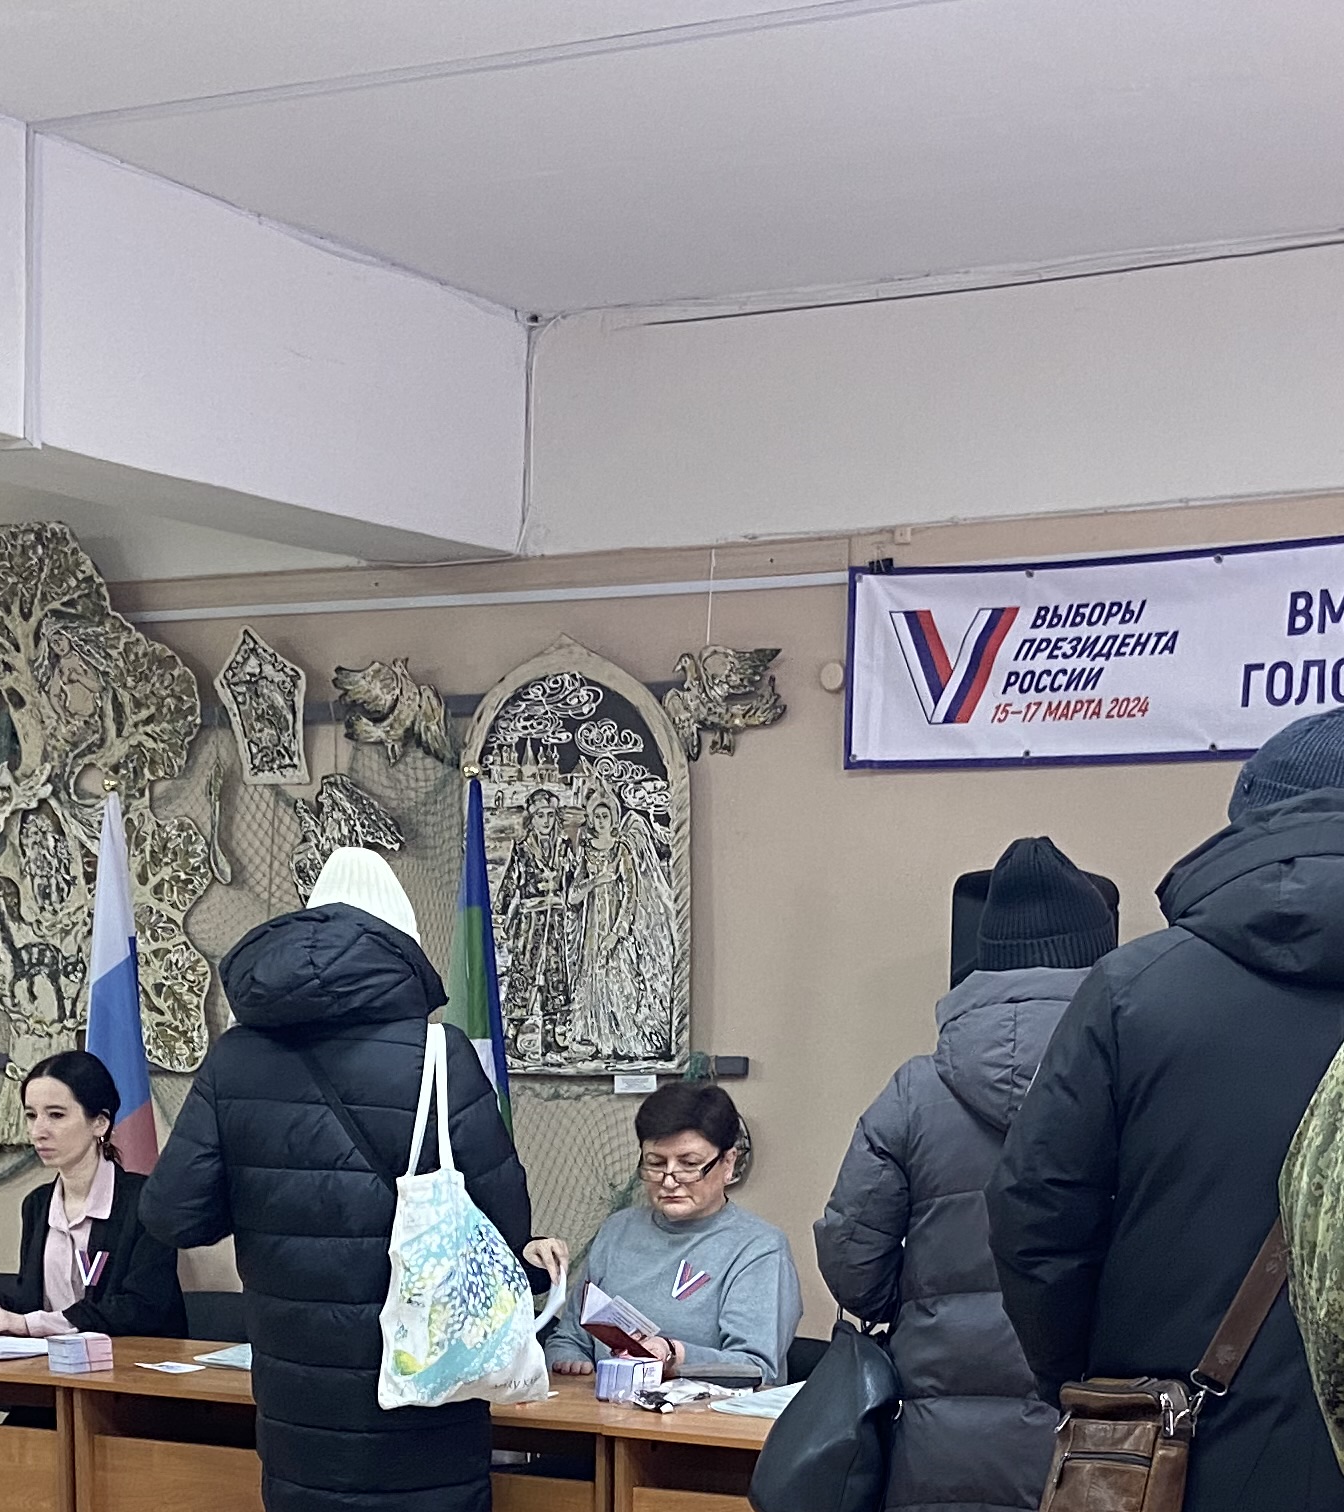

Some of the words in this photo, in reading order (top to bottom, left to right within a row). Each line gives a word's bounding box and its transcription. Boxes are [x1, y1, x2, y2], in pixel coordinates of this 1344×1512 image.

[1030, 599, 1147, 629] ВЫБОРЫ
[1013, 630, 1179, 662] ПРЕЗИДЕНТА
[1002, 667, 1104, 694] РОССИИ
[1042, 698, 1103, 722] МАРТА
[1105, 696, 1149, 719] 2024
